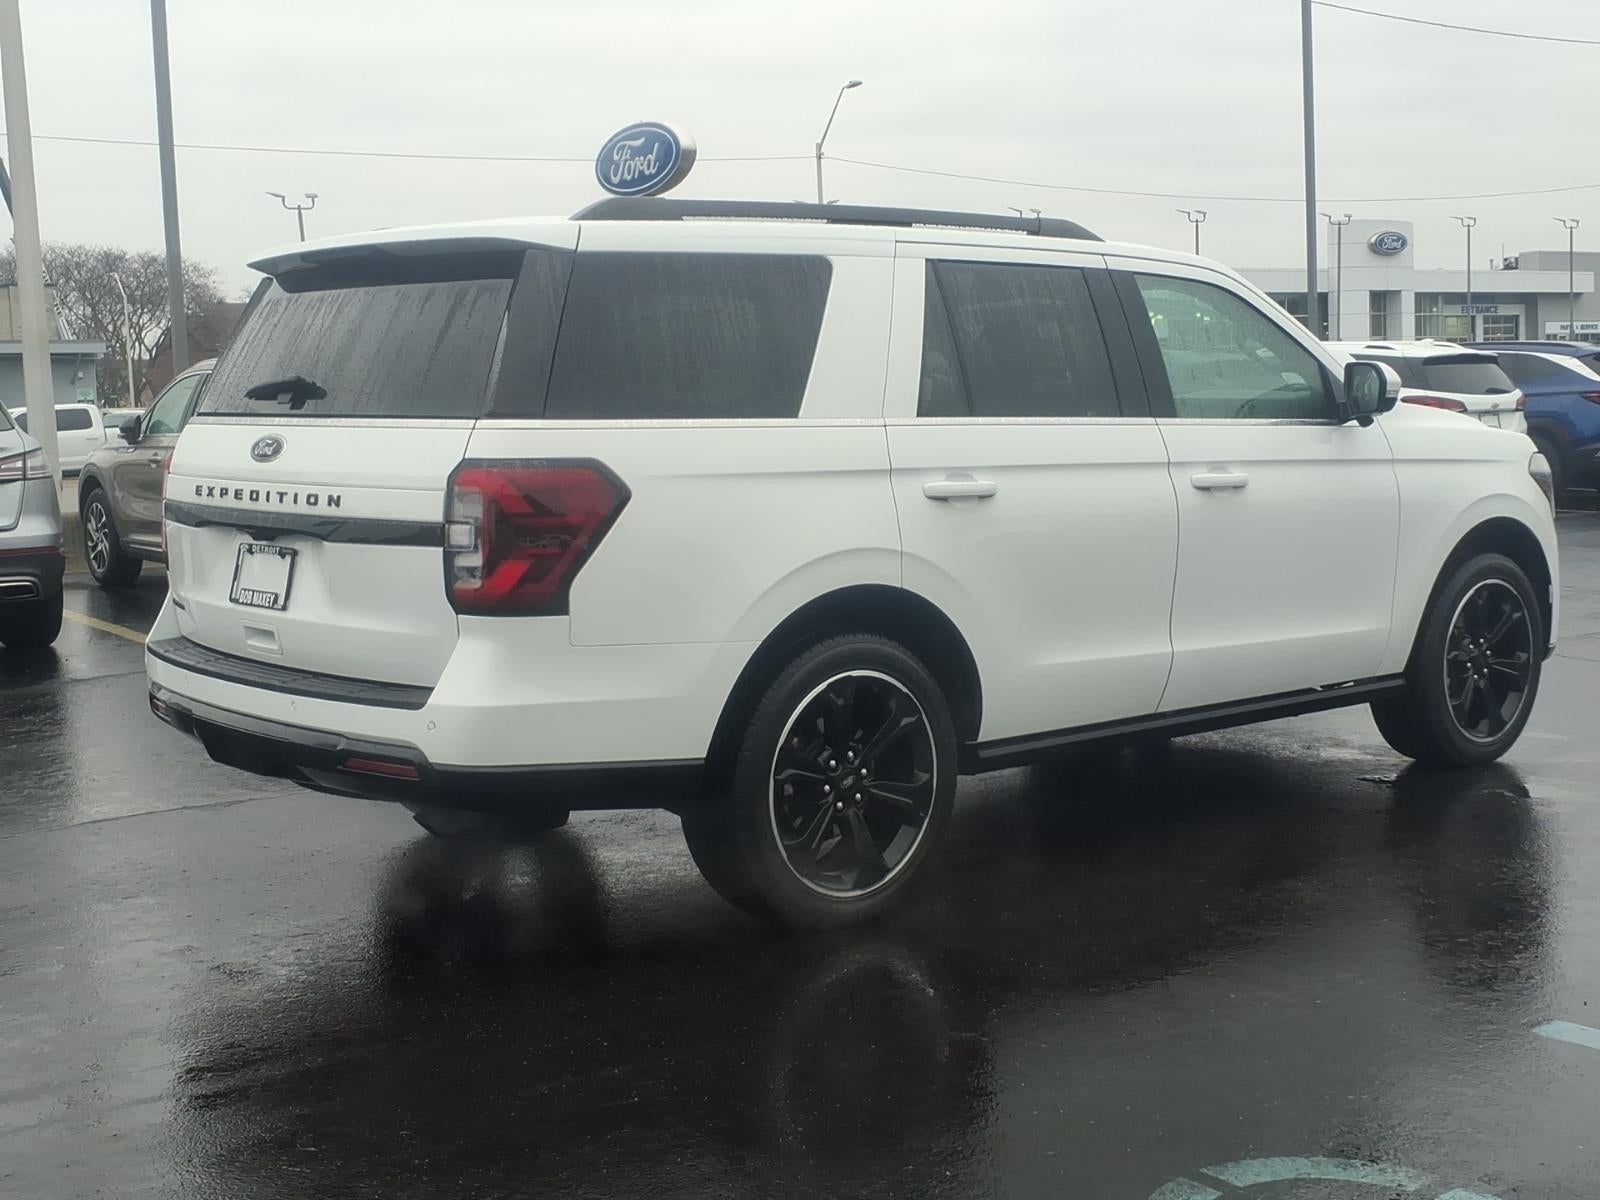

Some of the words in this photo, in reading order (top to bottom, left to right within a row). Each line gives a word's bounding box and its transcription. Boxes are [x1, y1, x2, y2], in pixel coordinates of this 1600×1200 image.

[610, 137, 660, 184] Ford
[1382, 235, 1403, 249] Ford
[254, 440, 277, 455] Ford
[195, 485, 342, 508] EXPEDITION
[252, 544, 280, 555] DETROIT
[239, 589, 253, 604] BOB
[252, 591, 276, 607] MAXEY
